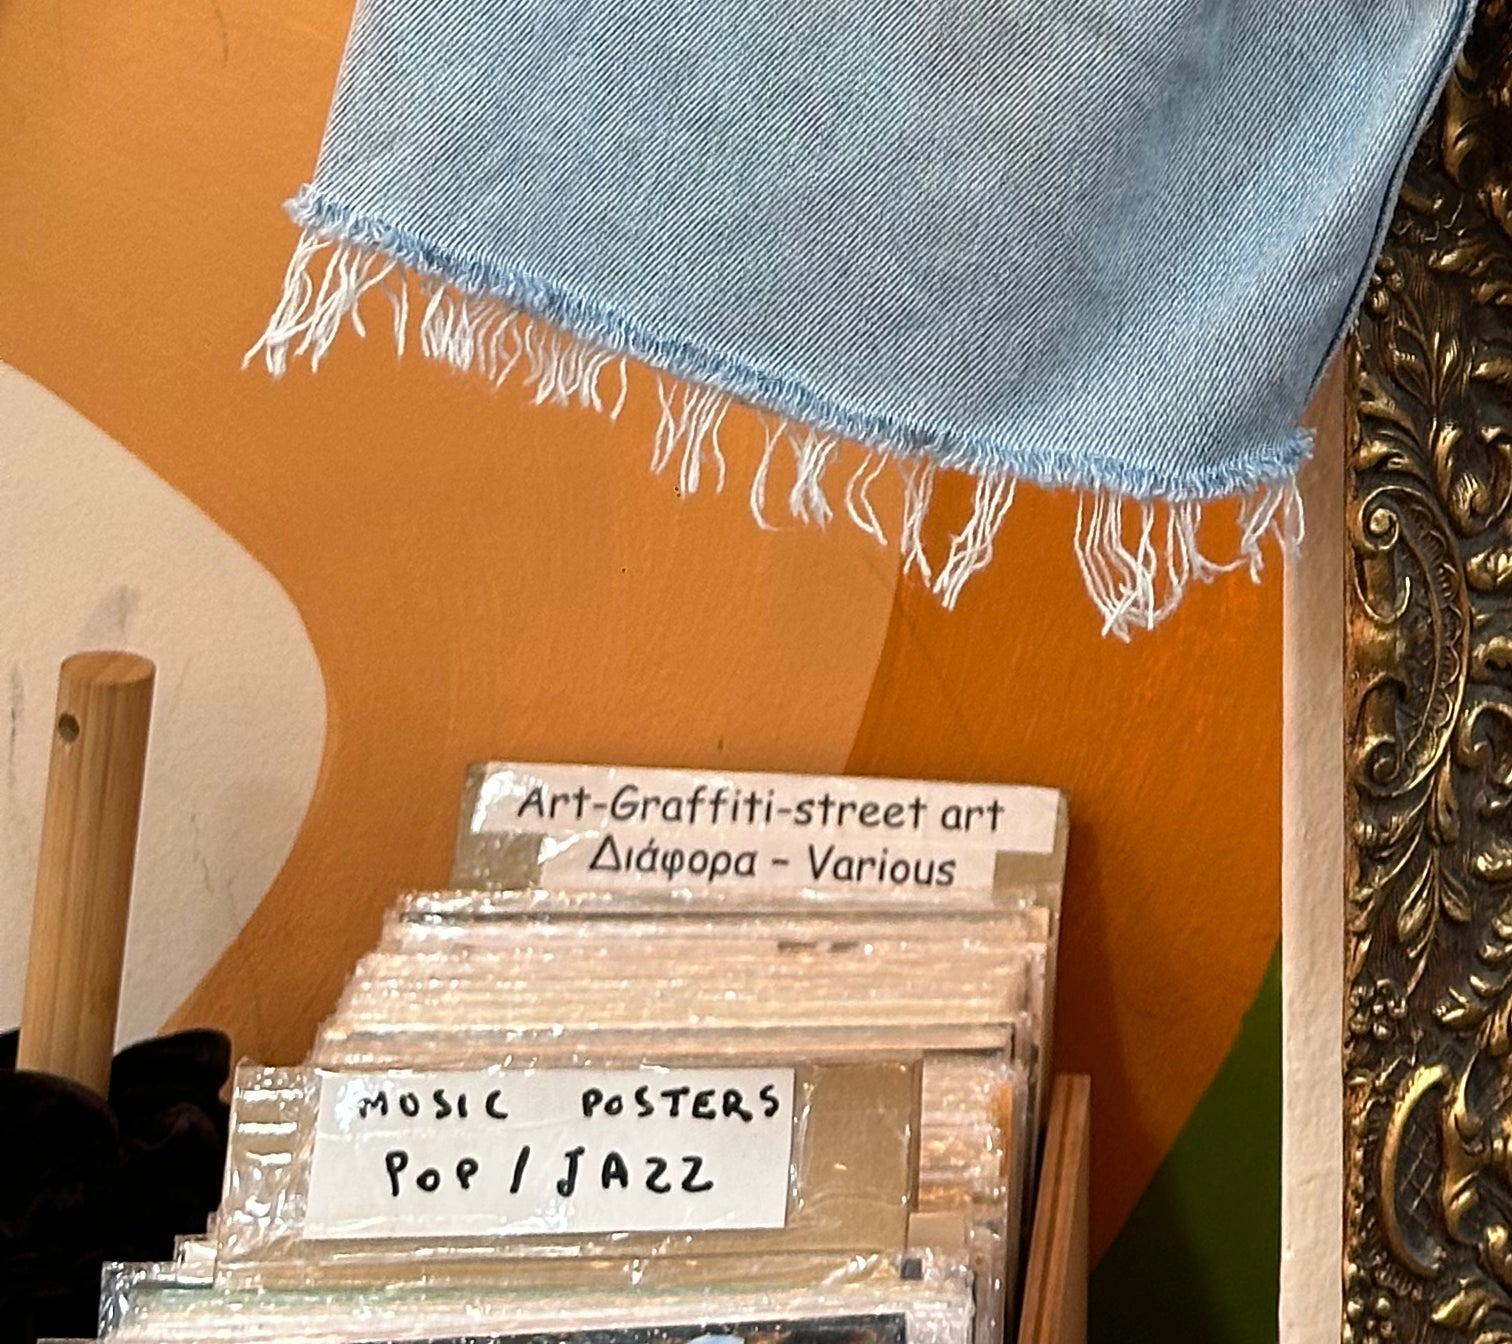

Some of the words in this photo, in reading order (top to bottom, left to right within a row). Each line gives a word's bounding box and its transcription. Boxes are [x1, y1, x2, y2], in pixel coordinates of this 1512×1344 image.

[941, 800, 1005, 832] art
[588, 834, 758, 883] Διάφορα
[808, 843, 956, 887] Various
[582, 1084, 780, 1123] POSTERS
